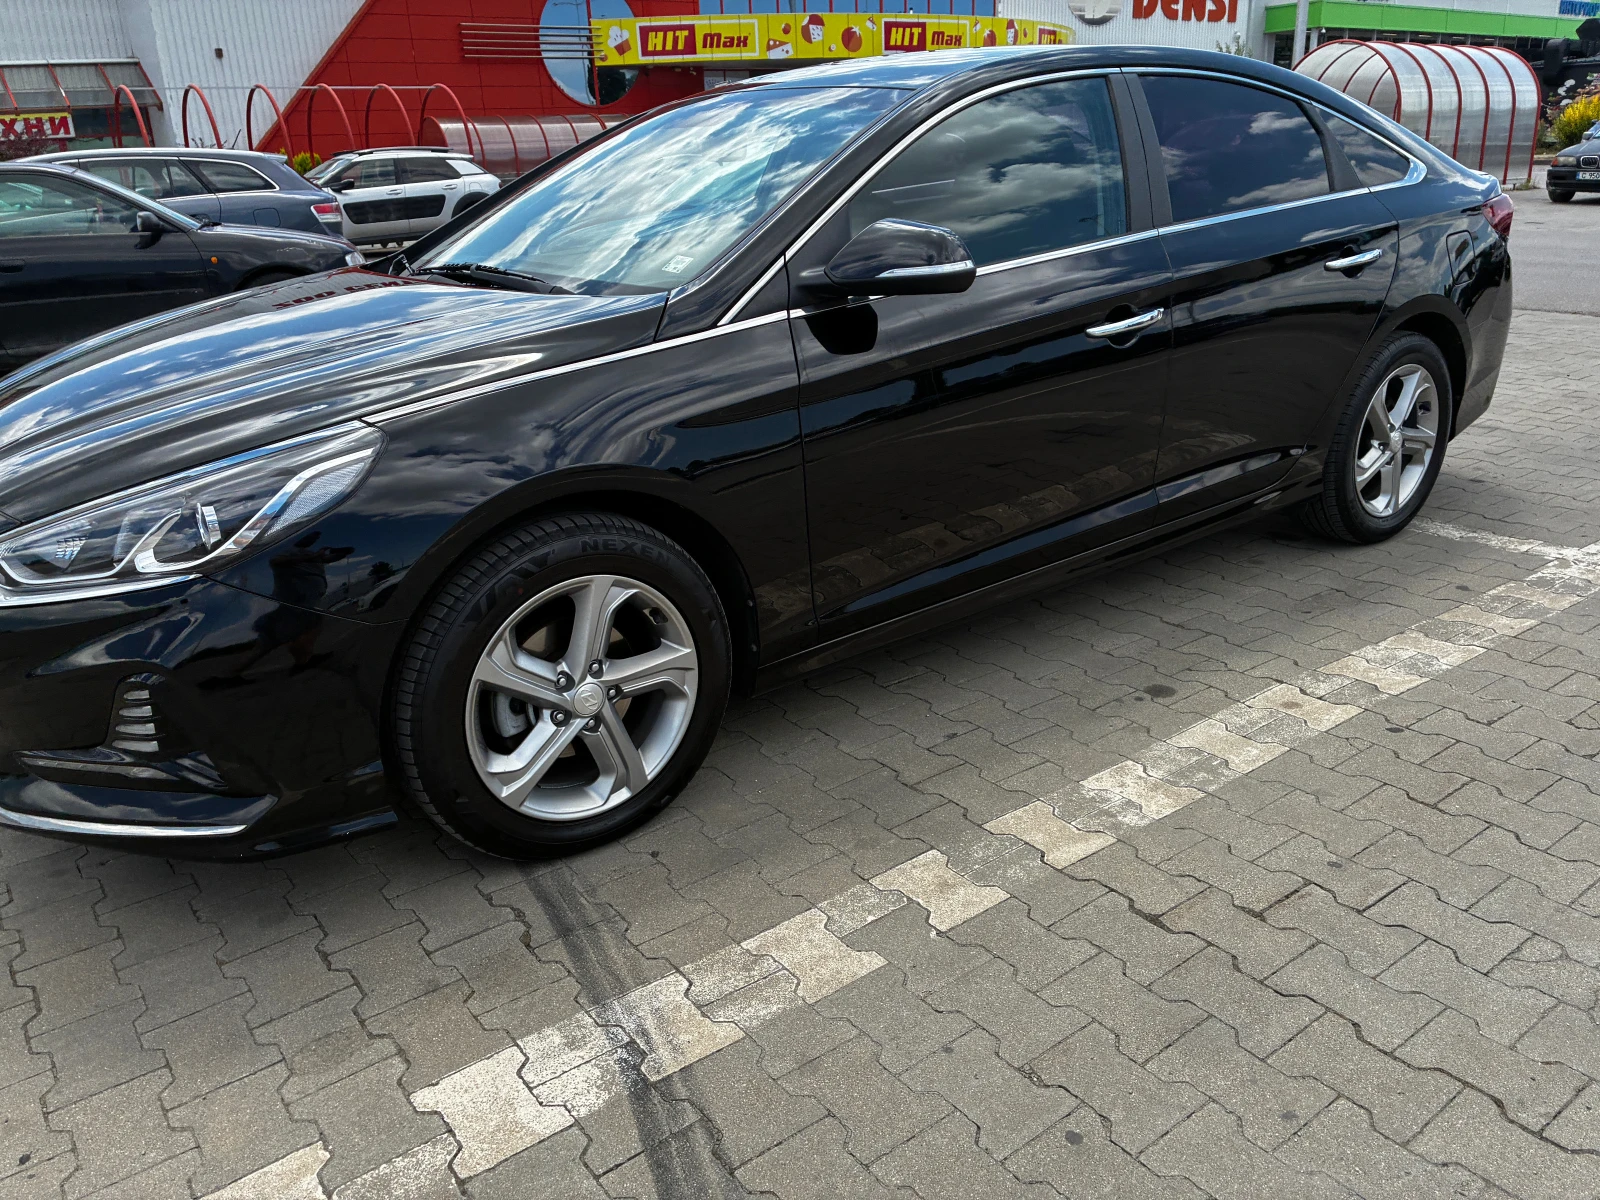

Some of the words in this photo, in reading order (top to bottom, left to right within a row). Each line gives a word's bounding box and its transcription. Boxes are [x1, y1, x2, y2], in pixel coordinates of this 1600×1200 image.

[647, 30, 689, 51] HIT
[702, 33, 749, 48] Max
[889, 27, 922, 46] HIT
[931, 30, 963, 46] Max
[580, 538, 672, 564] NEXEN
